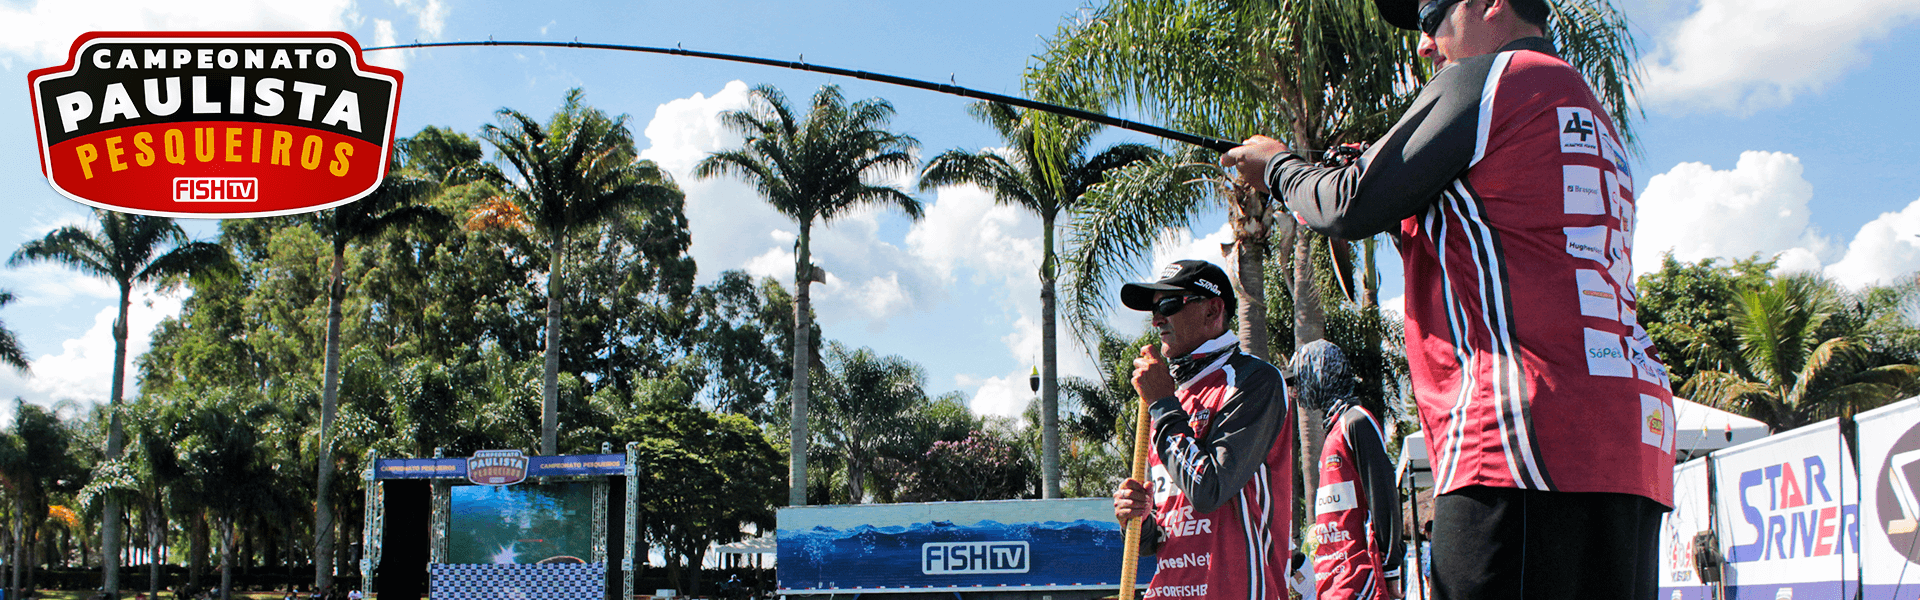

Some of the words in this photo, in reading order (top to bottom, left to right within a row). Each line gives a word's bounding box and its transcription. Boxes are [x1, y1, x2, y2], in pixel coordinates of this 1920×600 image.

[471, 457, 523, 470] PAULISTA
[583, 460, 621, 469] PESQUEIROS
[1764, 504, 1859, 561] RIVER
